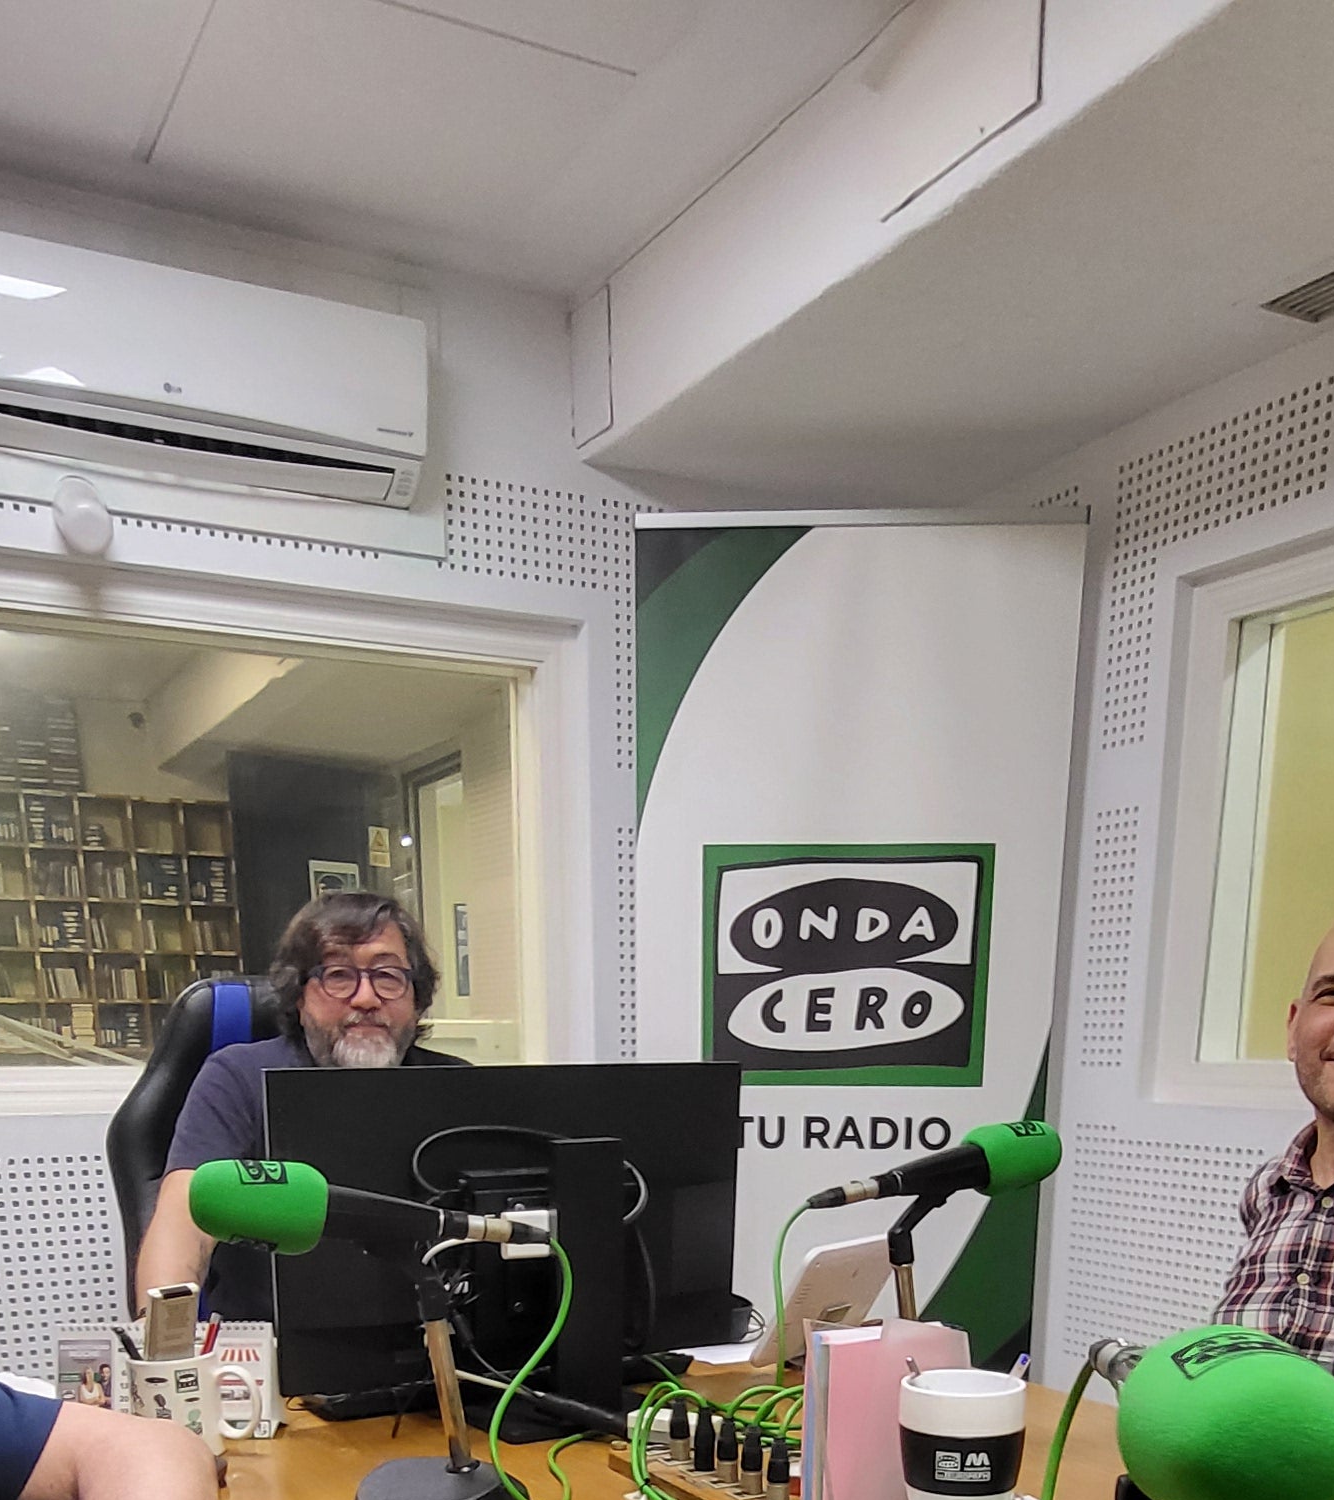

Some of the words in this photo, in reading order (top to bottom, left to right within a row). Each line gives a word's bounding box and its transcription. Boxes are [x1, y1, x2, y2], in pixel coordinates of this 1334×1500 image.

[751, 906, 936, 949] ONDA
[761, 986, 933, 1034] CERO
[803, 1114, 952, 1151] RADIO
